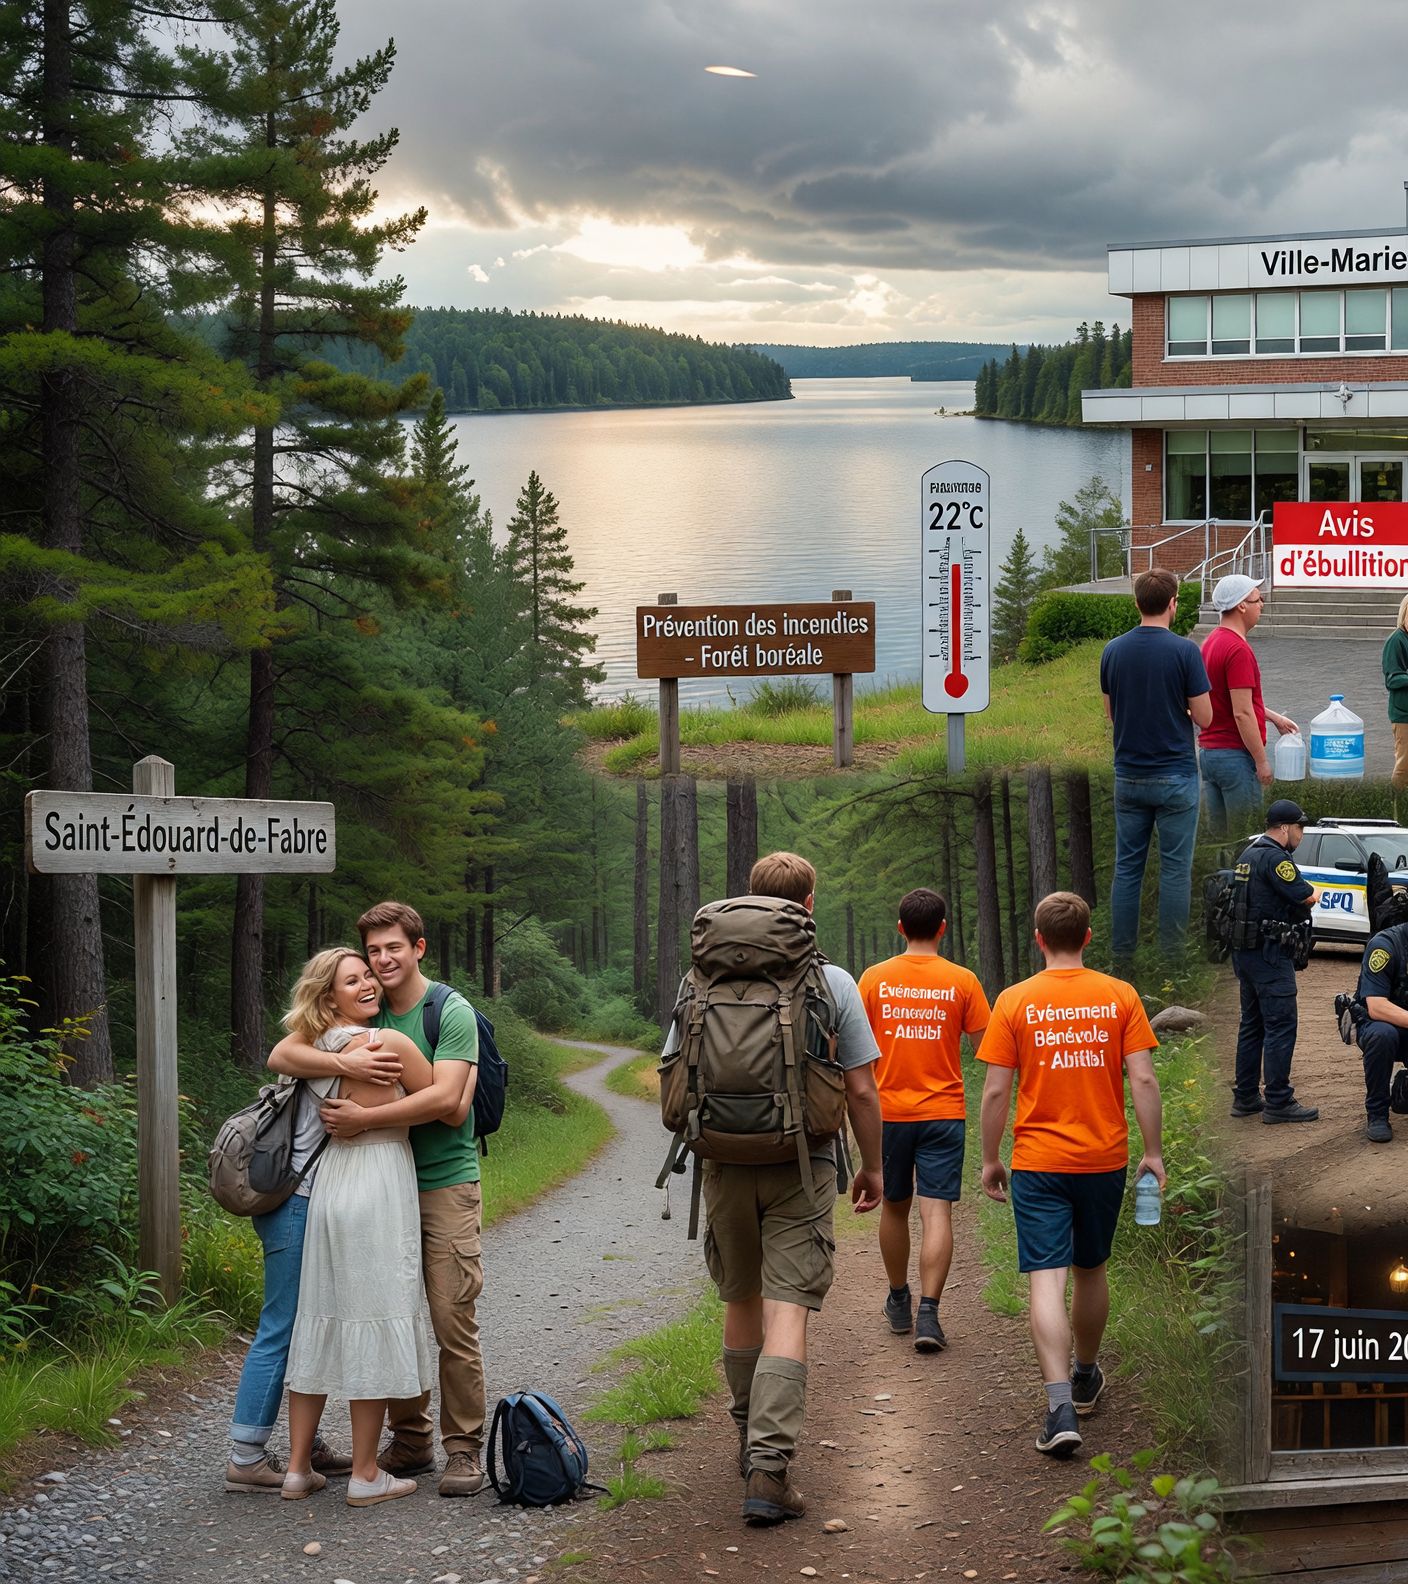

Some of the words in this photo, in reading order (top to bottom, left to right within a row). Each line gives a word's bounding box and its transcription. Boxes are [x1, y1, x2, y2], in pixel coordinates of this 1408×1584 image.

[1260, 243, 1408, 277] Ville-Marie
[929, 501, 983, 530] 22°C
[1318, 508, 1375, 538] Avis
[642, 614, 739, 639] Prévention
[744, 611, 777, 636] des
[783, 611, 869, 636] incendies
[700, 644, 749, 669] Forêt
[756, 642, 824, 666] boréale
[44, 805, 328, 854] Saint-Édouard-de-Fabre
[1320, 891, 1354, 913] SPQ
[1292, 1328, 1324, 1359] 17
[1331, 1329, 1380, 1368] juin
